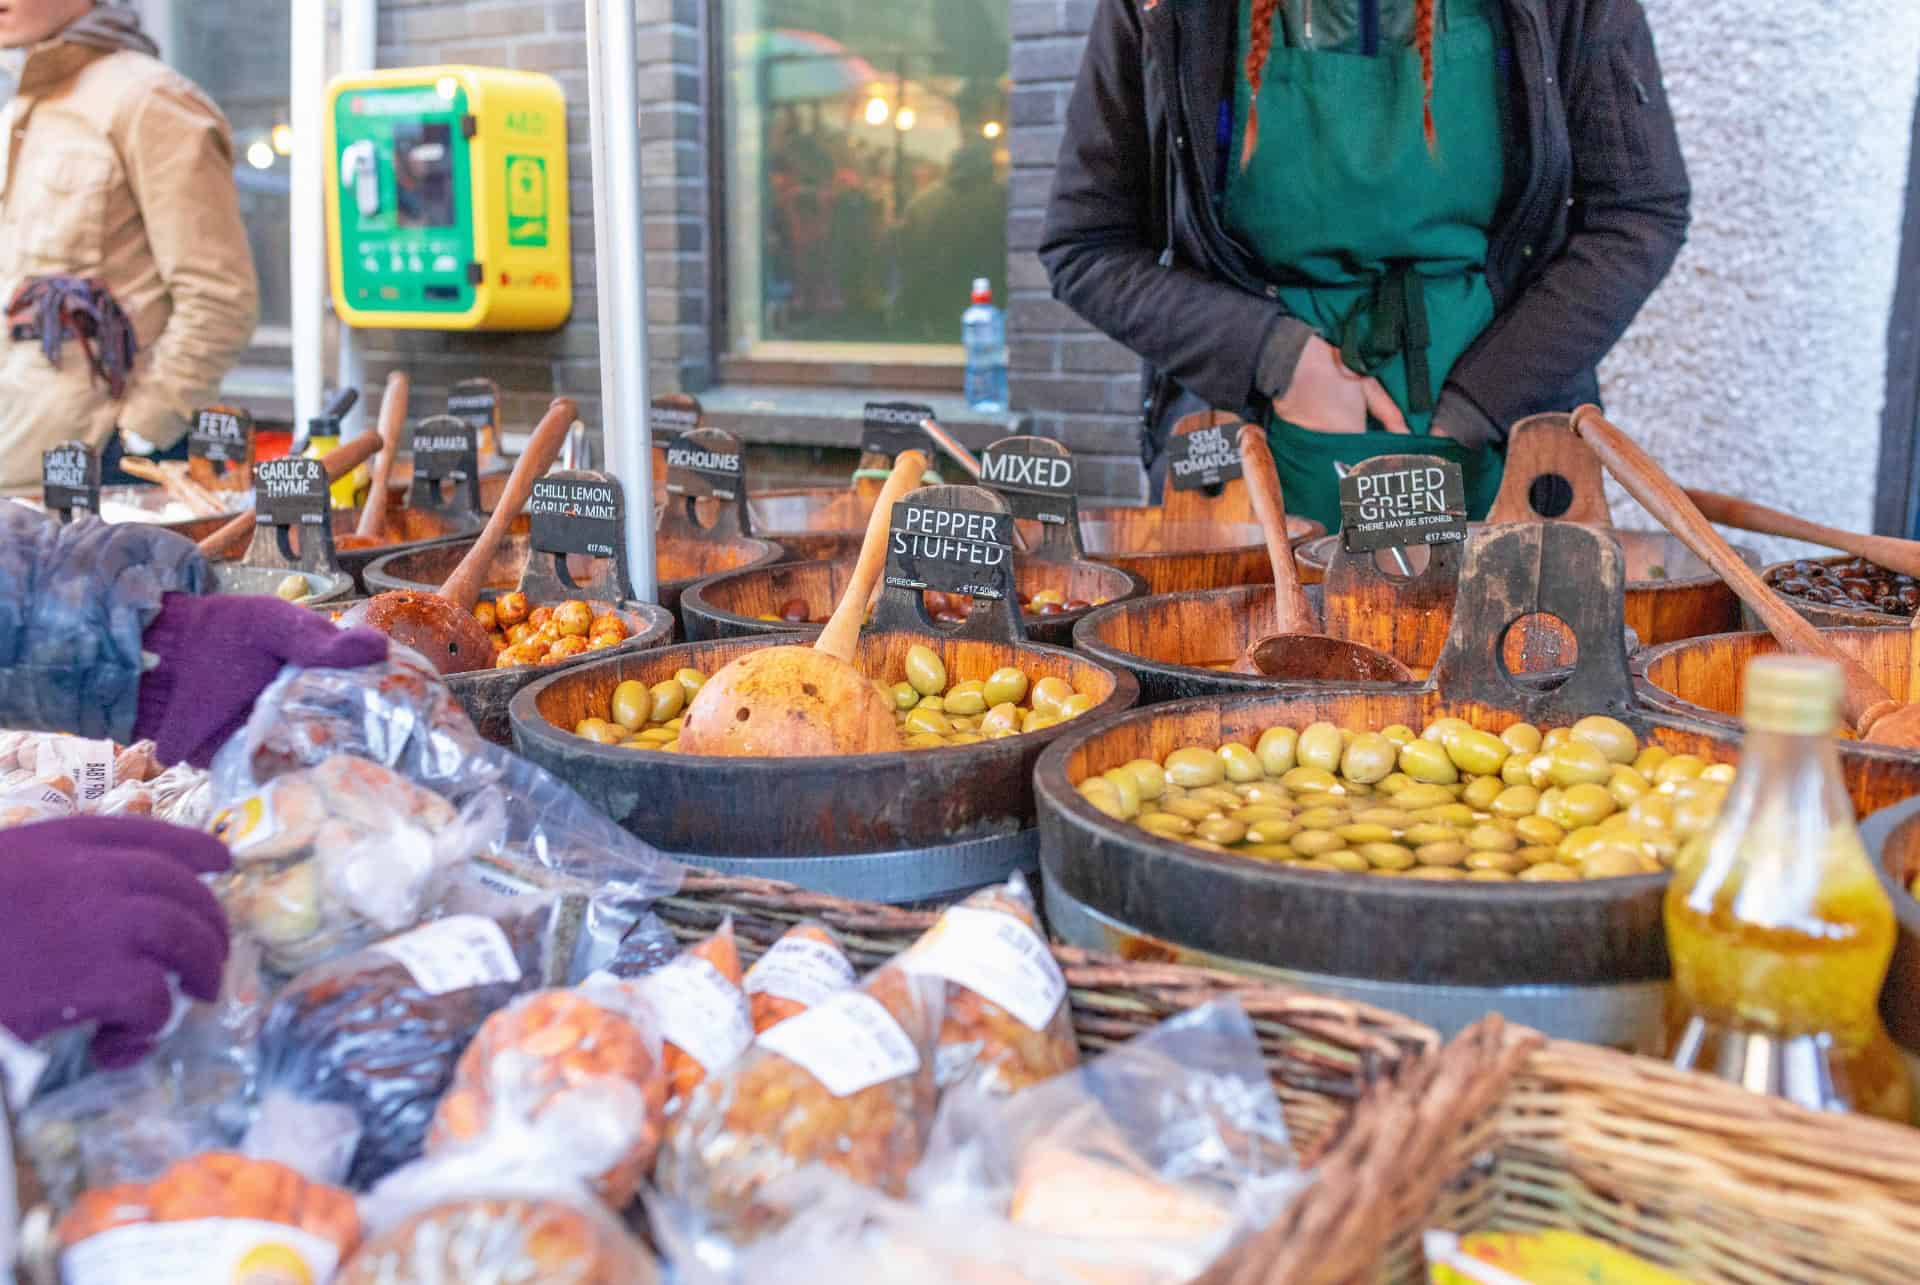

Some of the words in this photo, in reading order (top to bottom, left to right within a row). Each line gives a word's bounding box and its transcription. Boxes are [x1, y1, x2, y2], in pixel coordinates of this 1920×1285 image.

[199, 412, 240, 439] FETA
[259, 461, 304, 480] GARLIC
[307, 461, 320, 480] &
[667, 448, 740, 471] PICHOLINES
[981, 451, 1071, 487] MIXED
[266, 479, 310, 498] THYME
[533, 483, 568, 501] CHILLI,
[571, 485, 614, 505] LEMON,
[1357, 467, 1445, 499] PITTED
[532, 500, 570, 515] GARLIC
[1359, 489, 1446, 521] GREEN
[905, 507, 998, 541] PEPPER
[1358, 520, 1385, 532] THERE
[1385, 518, 1404, 529] MAY
[1405, 517, 1417, 527] BE
[893, 531, 1004, 566] STUFFED
[886, 576, 914, 587] GREEC
